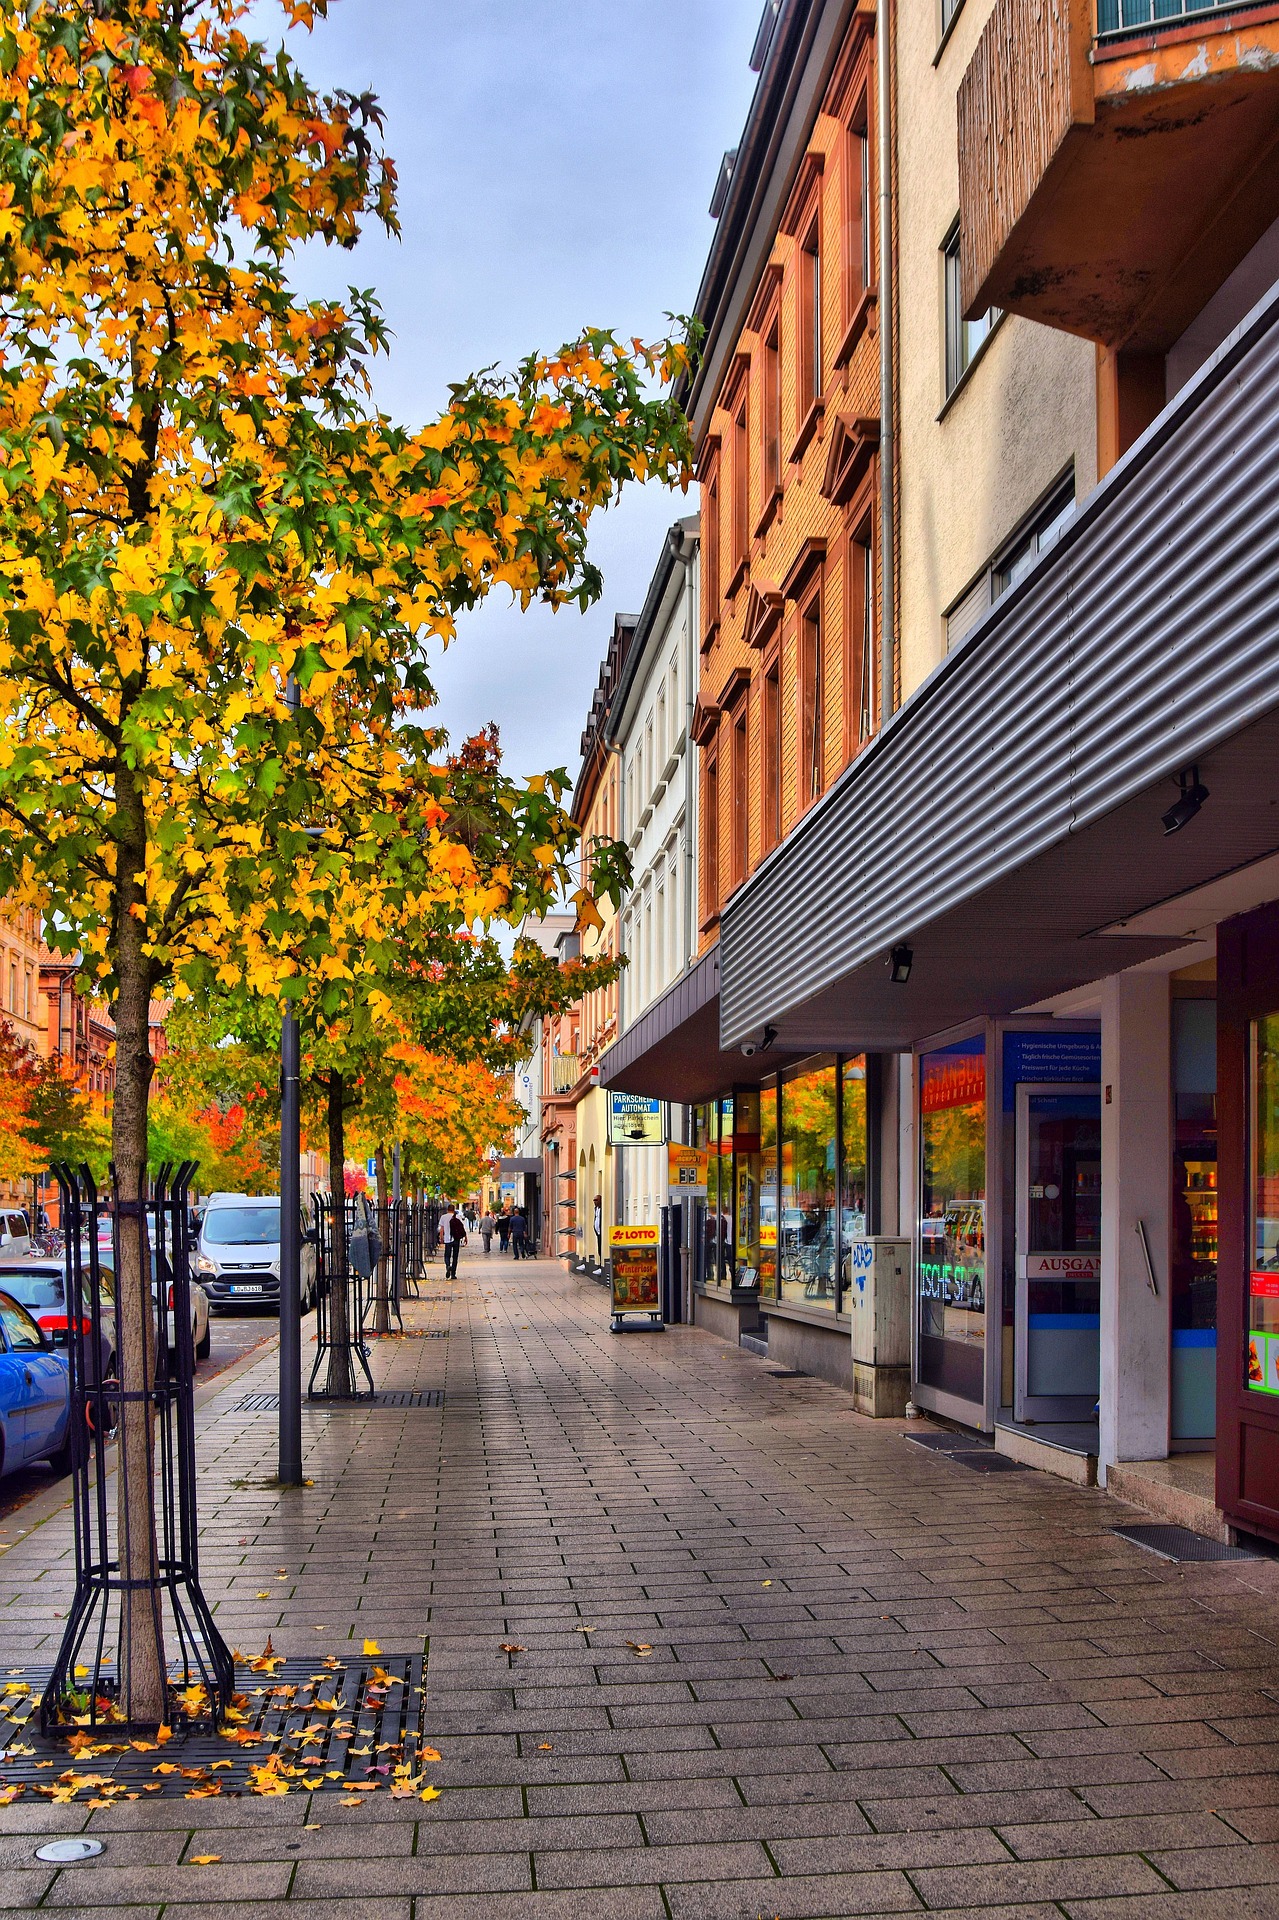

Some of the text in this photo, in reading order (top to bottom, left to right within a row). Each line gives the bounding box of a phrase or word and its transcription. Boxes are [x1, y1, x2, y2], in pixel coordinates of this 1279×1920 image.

[1021, 1053, 1041, 1061] Täglich
[924, 1081, 984, 1106] SUPERMARKT
[621, 1104, 651, 1113] AUTOMAT
[680, 1168, 697, 1184] 39
[625, 1230, 656, 1239] LOTTO
